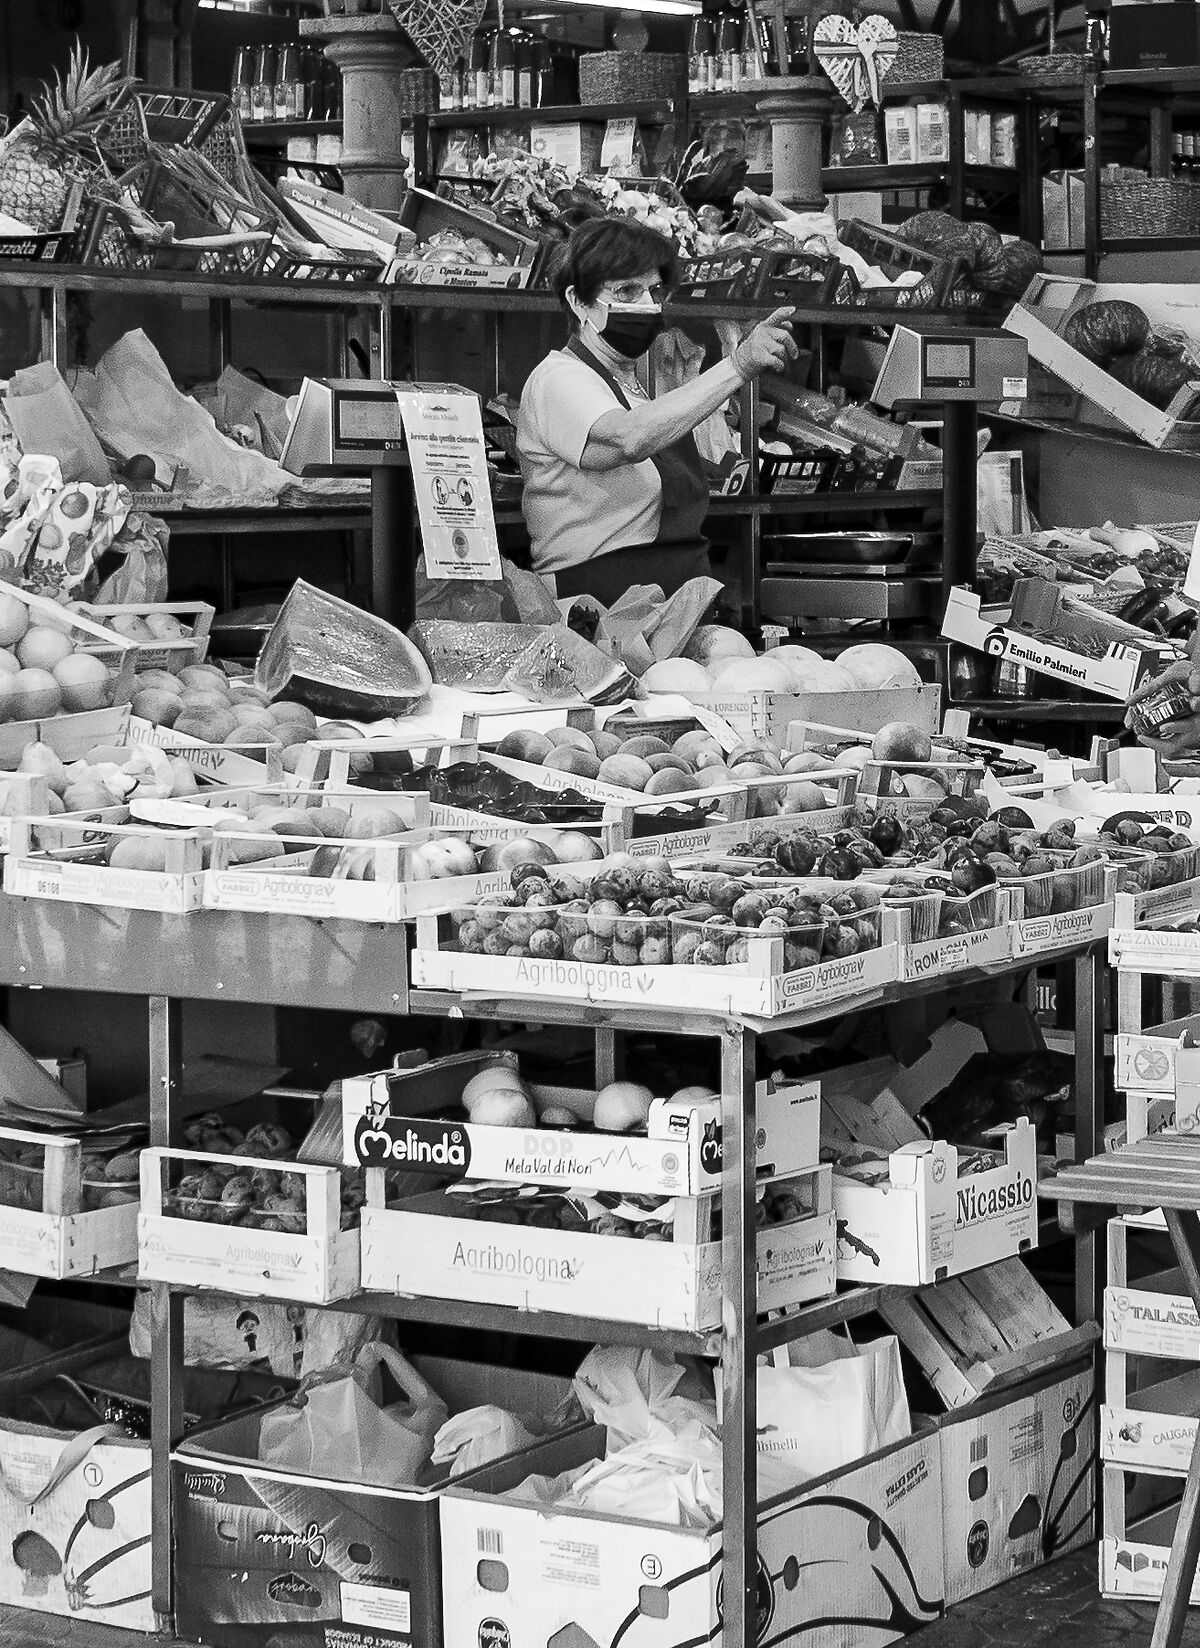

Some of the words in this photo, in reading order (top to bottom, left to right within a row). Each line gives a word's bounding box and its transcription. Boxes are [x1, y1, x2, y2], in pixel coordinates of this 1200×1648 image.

[1010, 643, 1042, 664] Emilio
[1043, 655, 1087, 680] Palmieri
[263, 877, 324, 898] Agribologna
[970, 932, 989, 946] MIA
[516, 958, 632, 993] Agribologna
[359, 1128, 466, 1167] Melinda
[523, 1134, 574, 1158] DOP
[504, 1158, 532, 1174] Mela
[533, 1158, 551, 1174] Val
[567, 1158, 592, 1175] Non
[956, 1170, 1033, 1225] Nicassio
[226, 1243, 293, 1267] Agribologna
[453, 1241, 572, 1282] Agribologna
